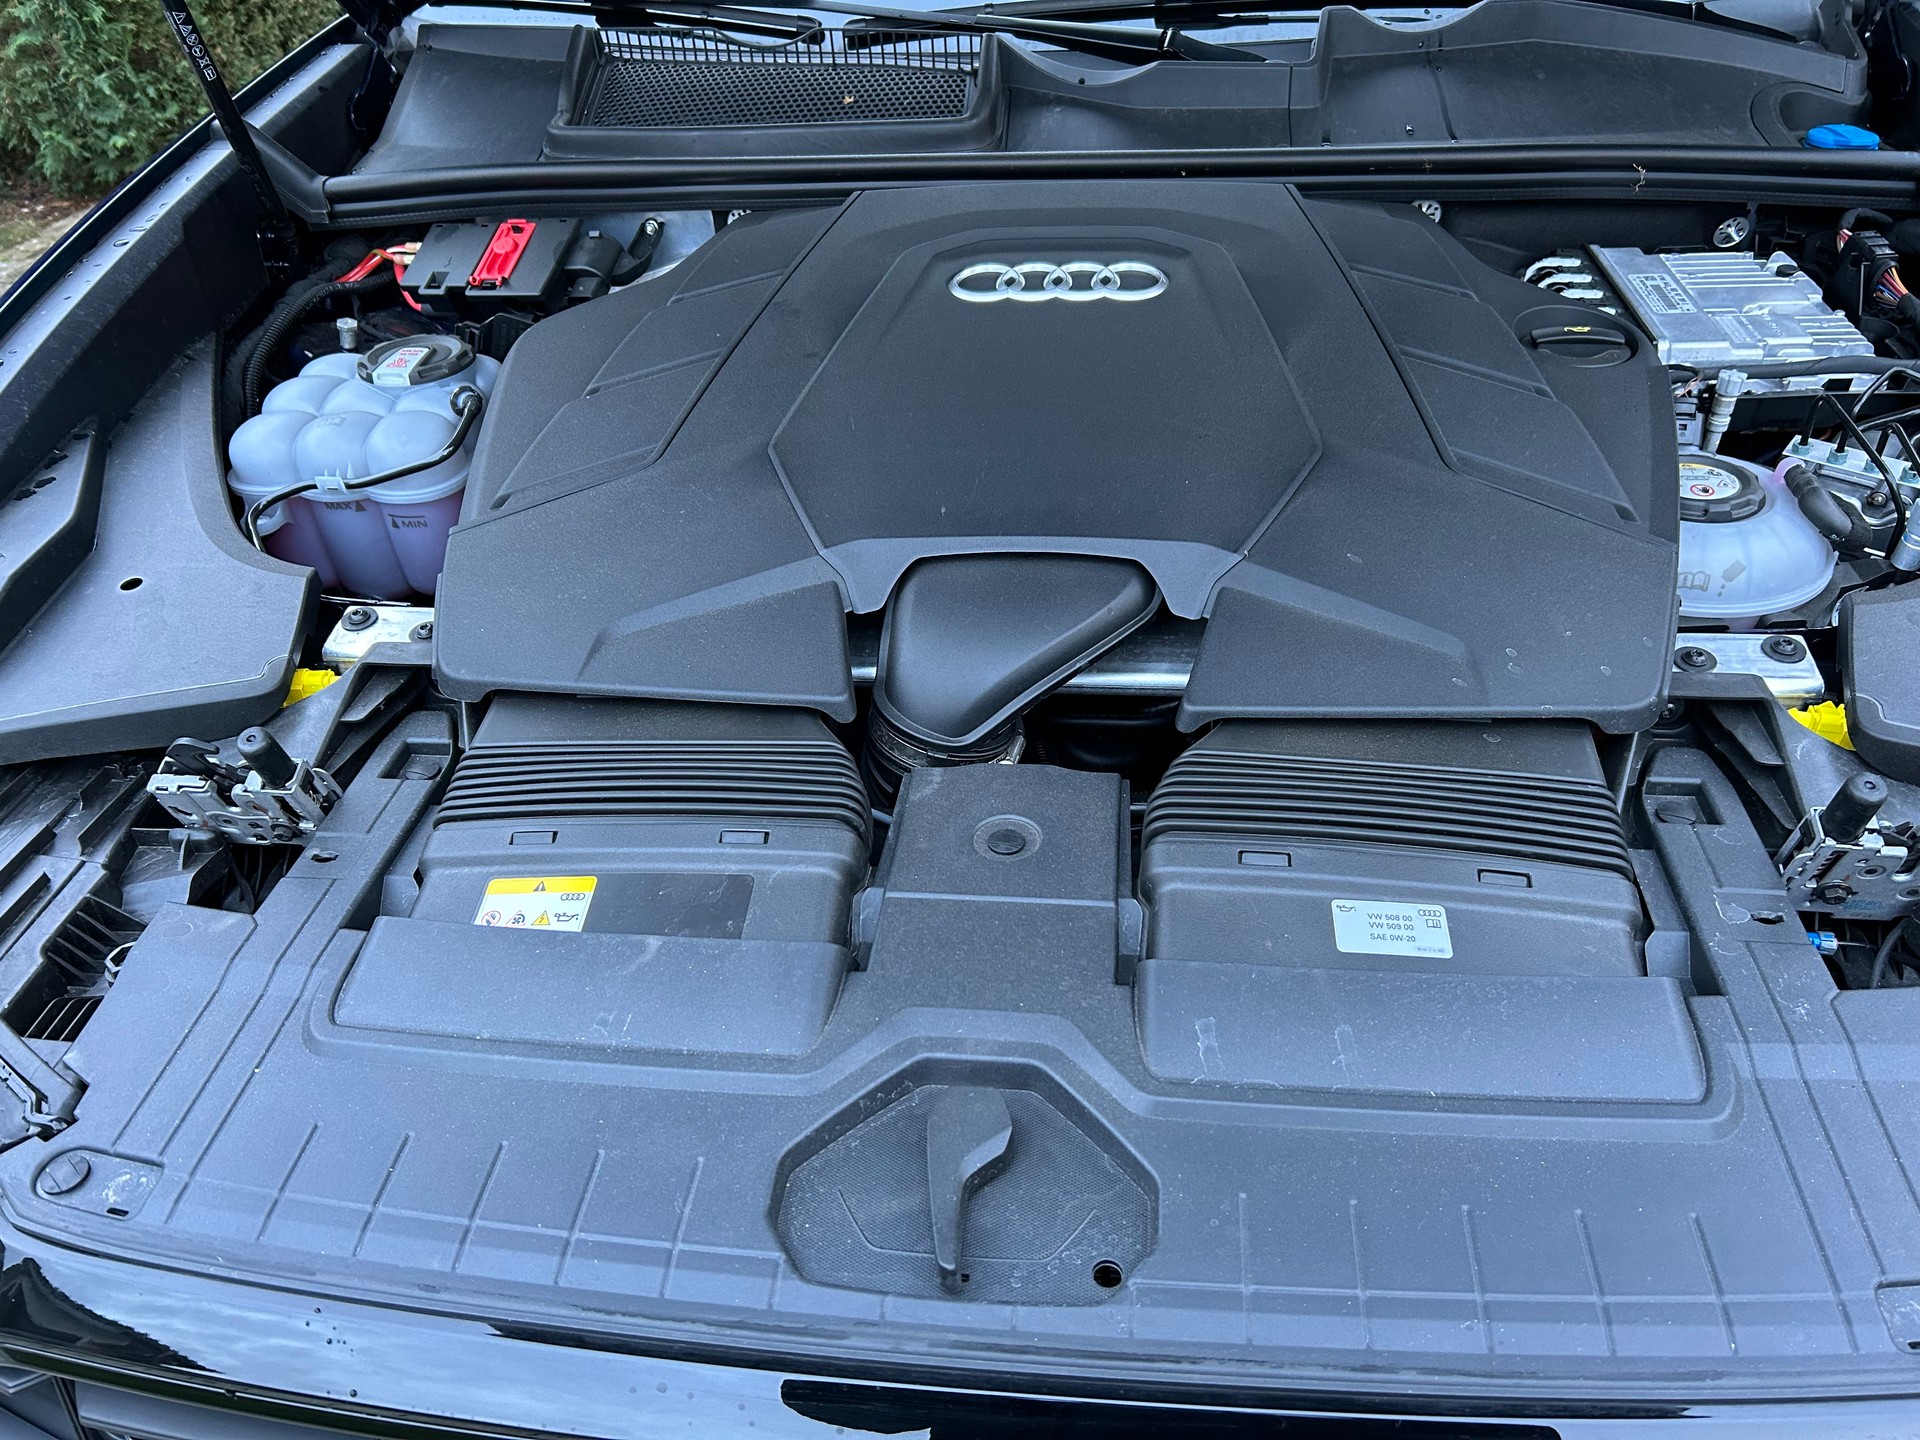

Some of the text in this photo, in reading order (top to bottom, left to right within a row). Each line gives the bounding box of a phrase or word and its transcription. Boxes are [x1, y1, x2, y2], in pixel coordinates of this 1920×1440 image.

[325, 501, 352, 510] MAX
[401, 520, 428, 528] MIN
[1368, 921, 1384, 929] VW
[1370, 933, 1416, 942] SAE 0W-20
